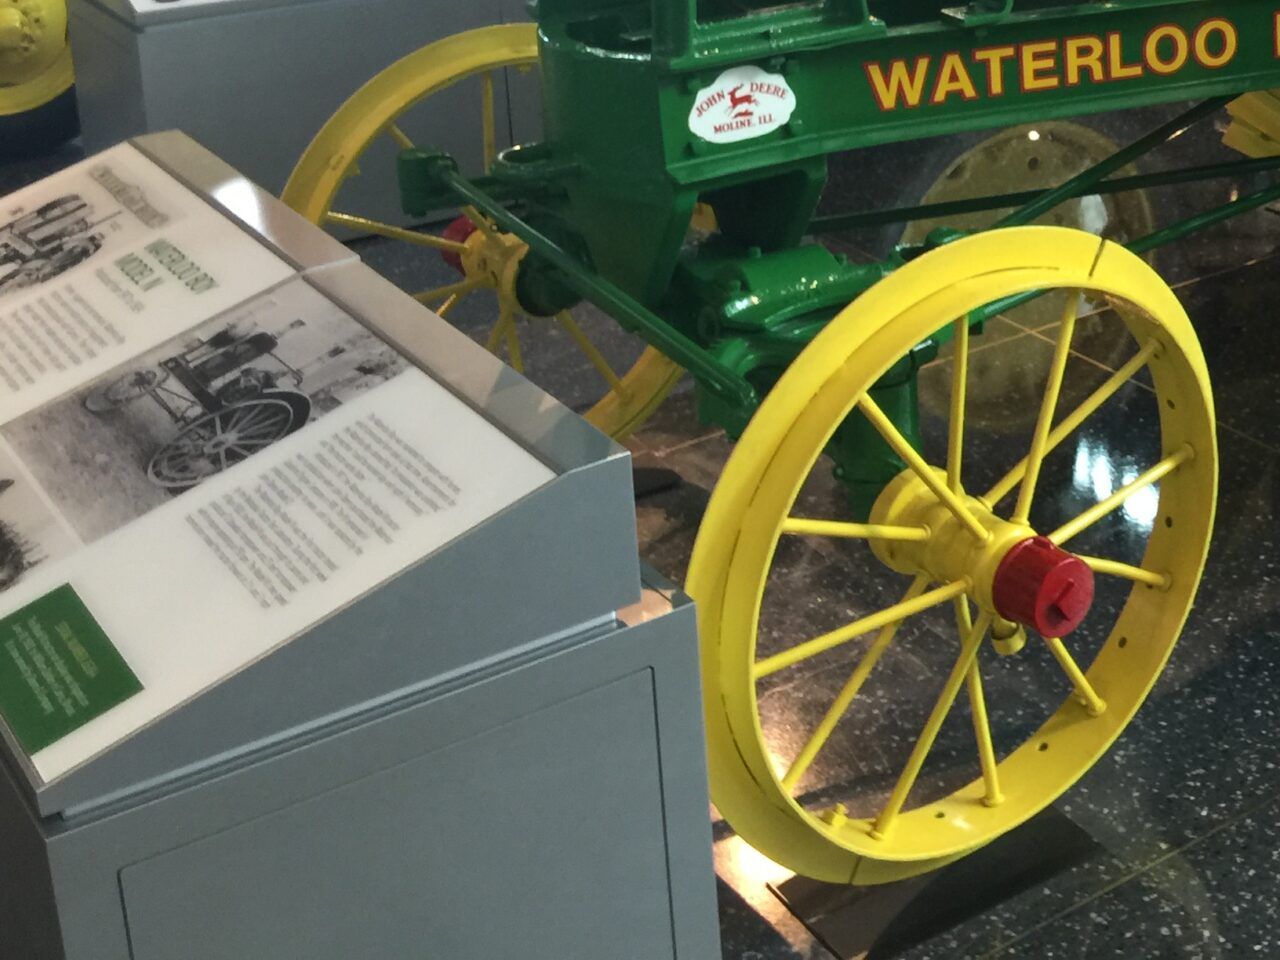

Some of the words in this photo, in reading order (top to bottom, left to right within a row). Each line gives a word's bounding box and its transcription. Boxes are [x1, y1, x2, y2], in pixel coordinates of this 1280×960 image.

[863, 16, 1238, 112] WATERLOO
[696, 90, 725, 118] JOHN
[750, 81, 788, 100] DEERE
